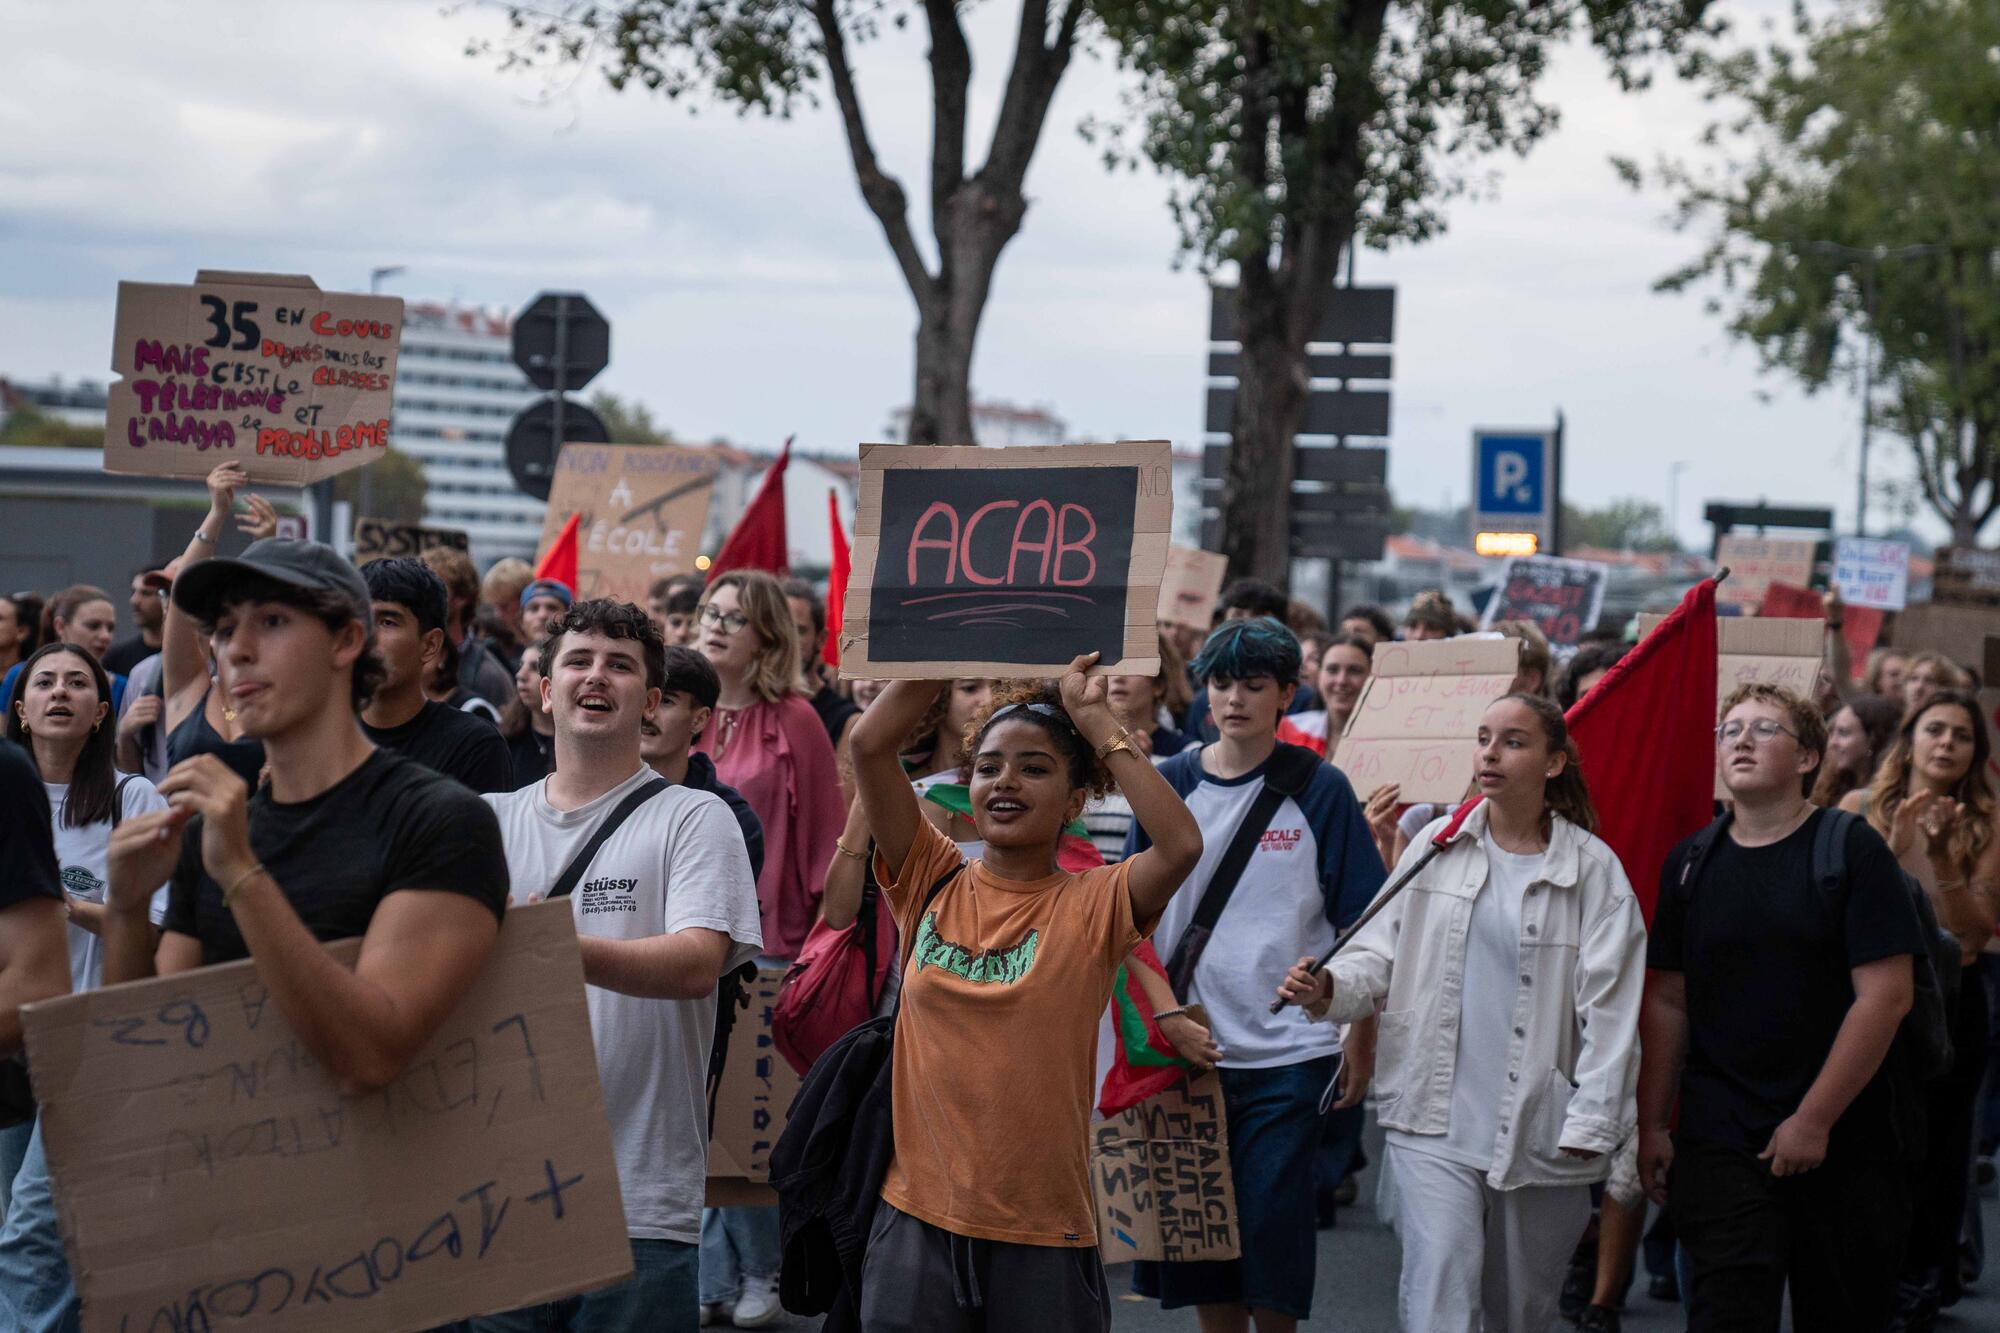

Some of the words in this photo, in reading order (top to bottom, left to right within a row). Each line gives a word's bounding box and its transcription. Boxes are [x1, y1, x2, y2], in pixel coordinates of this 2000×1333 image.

[200, 295, 261, 350] 35
[276, 306, 305, 327] EN
[588, 519, 685, 556] ÉCOLE
[907, 498, 1097, 586] ACAB
[583, 877, 639, 893] stüssy
[915, 911, 1038, 986] VOLCOM
[1127, 1139, 1153, 1213] PAS
[1191, 1094, 1232, 1249] FRANCE
